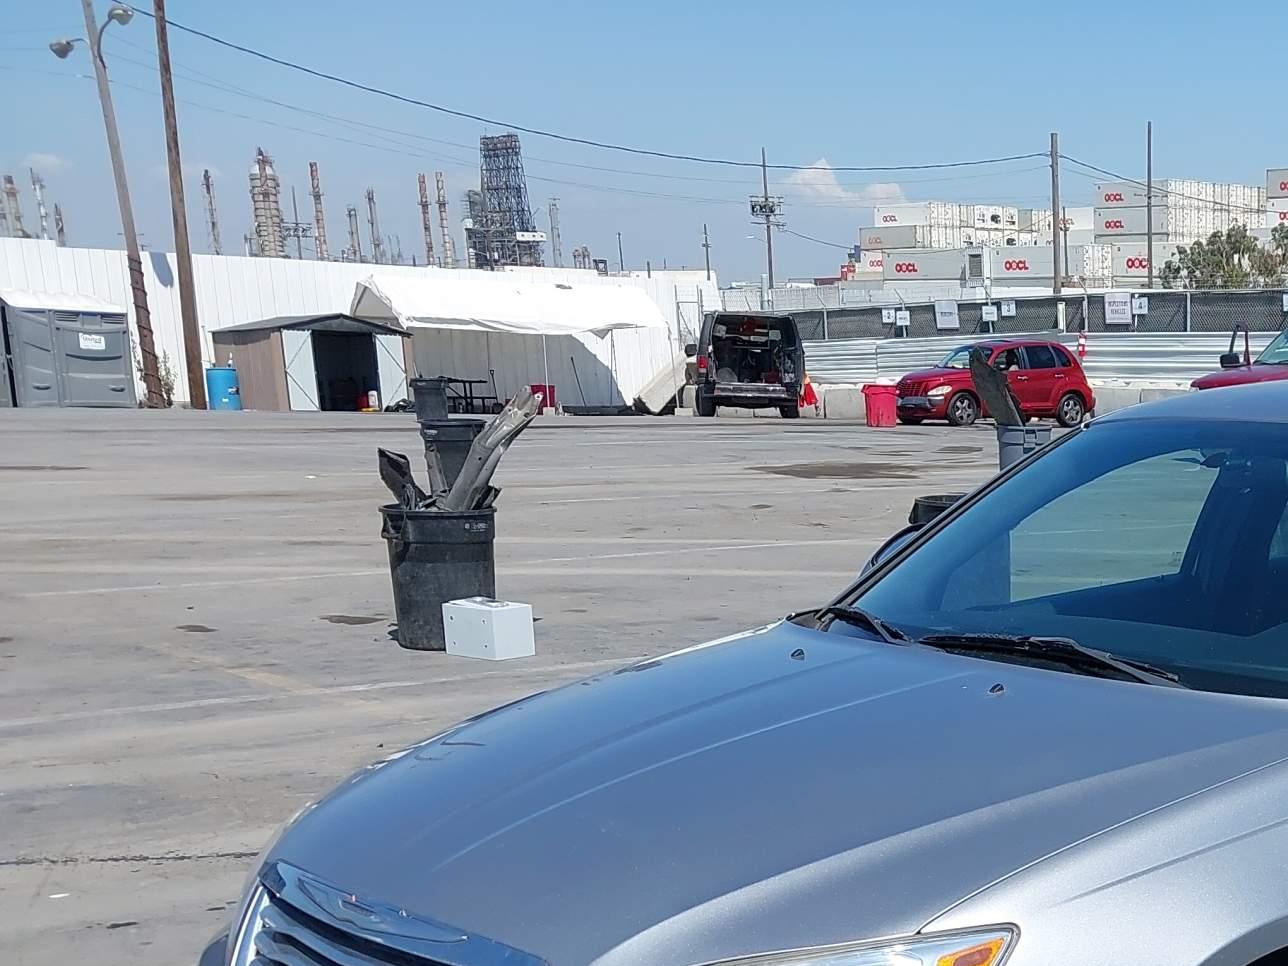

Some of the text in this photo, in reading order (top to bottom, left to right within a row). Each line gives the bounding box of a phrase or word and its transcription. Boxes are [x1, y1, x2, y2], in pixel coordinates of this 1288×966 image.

[1104, 193, 1124, 202] OOCL
[882, 215, 897, 223] OOCL
[1105, 220, 1124, 229] OOCL
[895, 262, 918, 273] OOCL
[1004, 260, 1029, 271] OOCL
[1126, 257, 1149, 269] OOC
